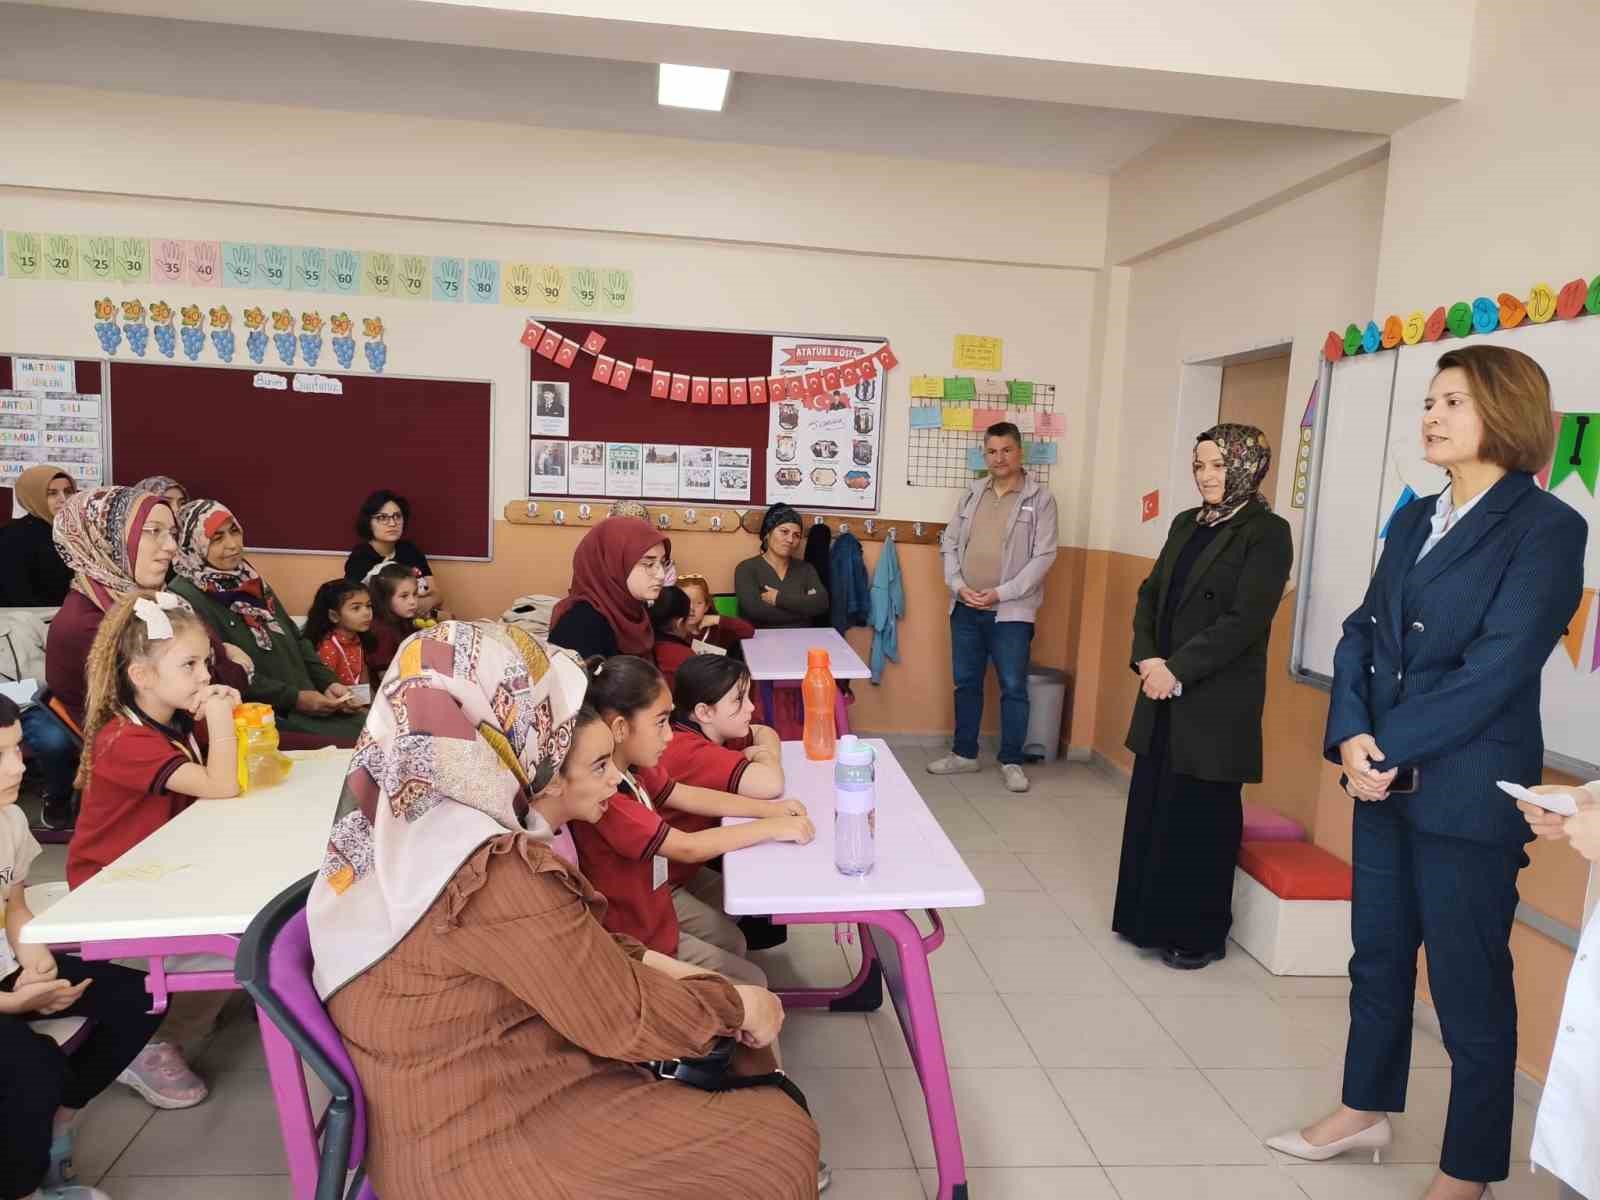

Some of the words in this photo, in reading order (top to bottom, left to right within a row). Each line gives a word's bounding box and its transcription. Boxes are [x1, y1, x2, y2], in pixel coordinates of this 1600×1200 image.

[20, 256, 35, 267] 15
[54, 258, 69, 269] 20
[93, 259, 108, 270] 25
[127, 260, 141, 272] 30
[165, 262, 180, 273] 35
[197, 264, 212, 275] 40
[235, 266, 249, 278] 45
[268, 267, 282, 279] 50
[305, 269, 320, 281] 55
[338, 273, 352, 284] 60
[375, 275, 389, 286] 65
[407, 277, 421, 289] 70
[444, 280, 458, 292] 75
[477, 282, 491, 293] 80
[513, 285, 528, 296] 85
[545, 287, 559, 298] 90
[580, 289, 594, 301] 95
[1533, 287, 1551, 318] 10
[1455, 307, 1468, 329] 7
[1477, 300, 1490, 328] 8
[1408, 316, 1419, 340] 5
[1569, 415, 1591, 466] I
